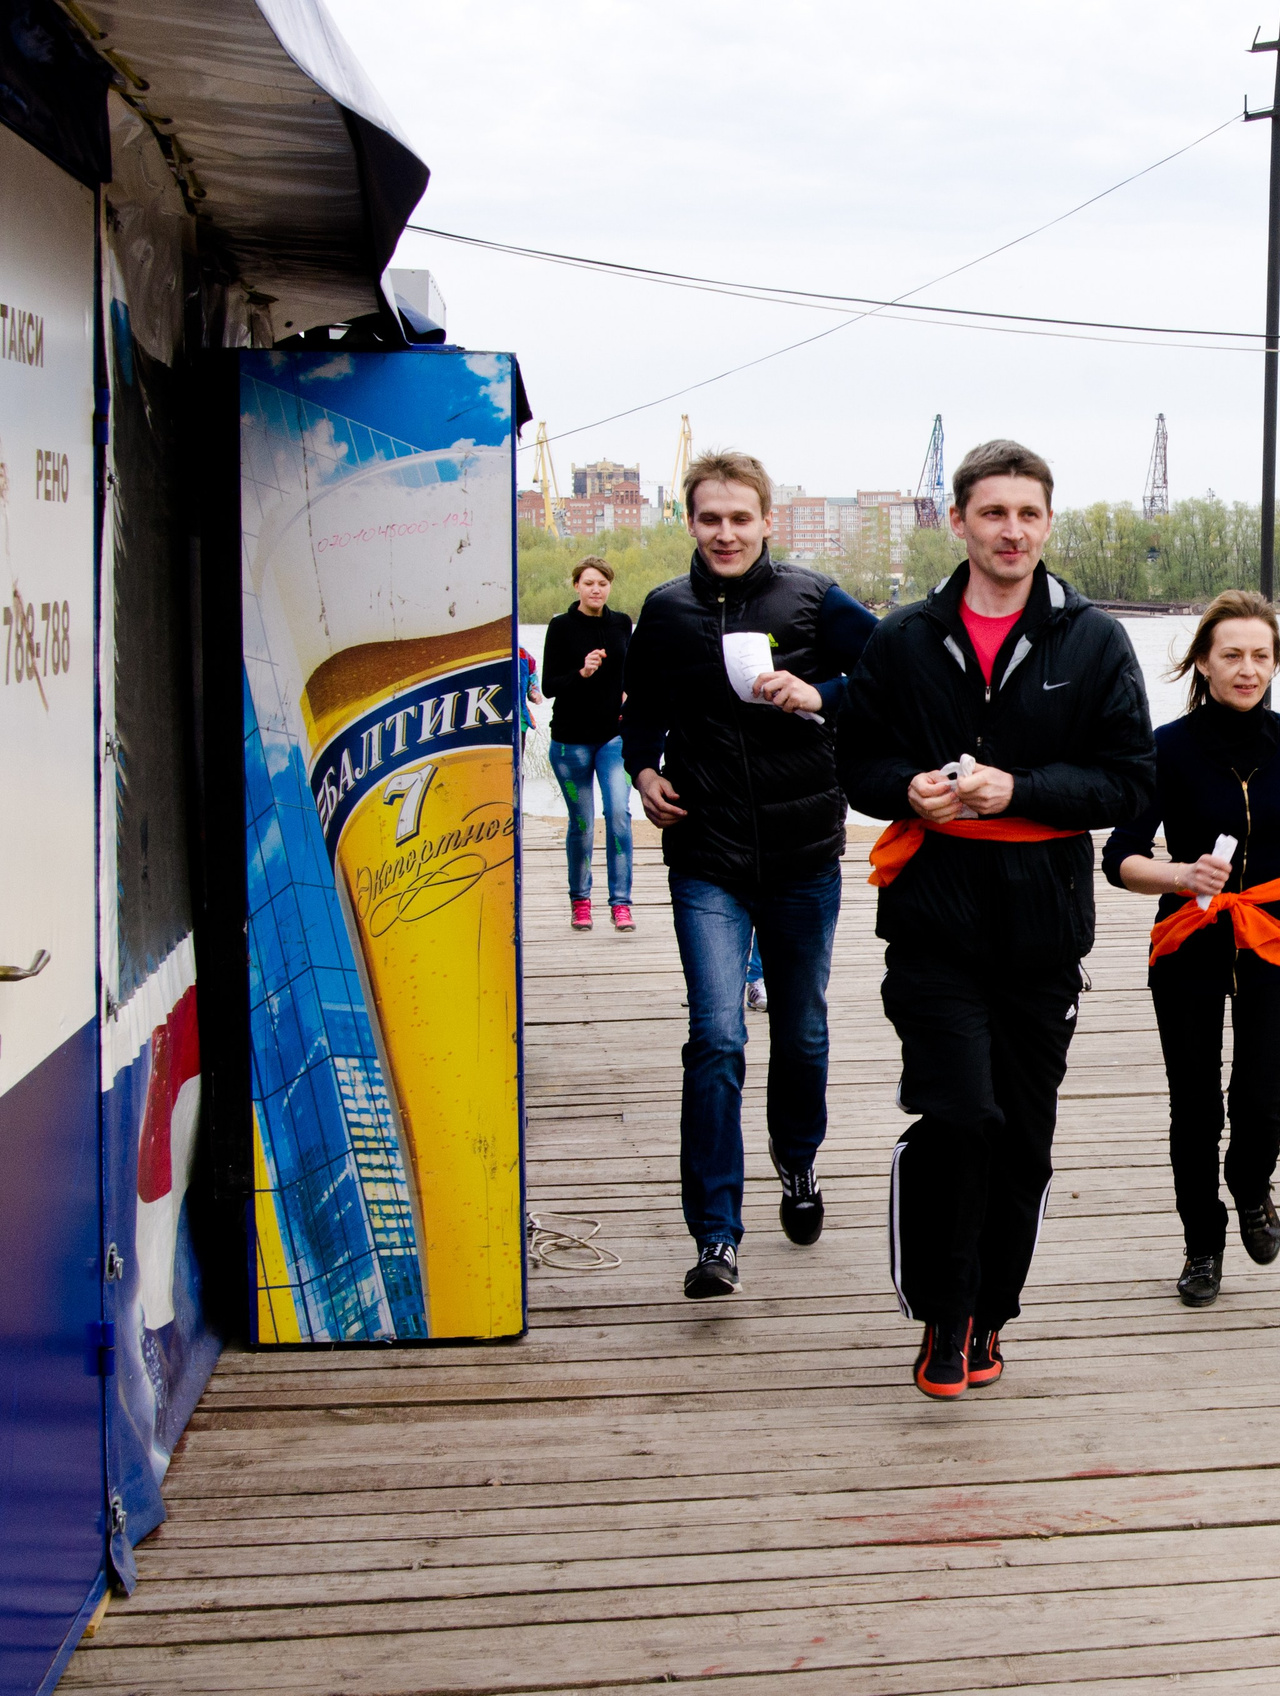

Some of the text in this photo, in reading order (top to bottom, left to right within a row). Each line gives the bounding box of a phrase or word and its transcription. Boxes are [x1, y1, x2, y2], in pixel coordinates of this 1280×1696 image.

[0, 304, 44, 368] ТАКСИ
[36, 449, 69, 503] РЕНО
[3, 600, 70, 685] 788-788
[321, 684, 514, 822] БАЛТИК
[383, 763, 438, 848] 7
[356, 817, 514, 920] Экспортное
